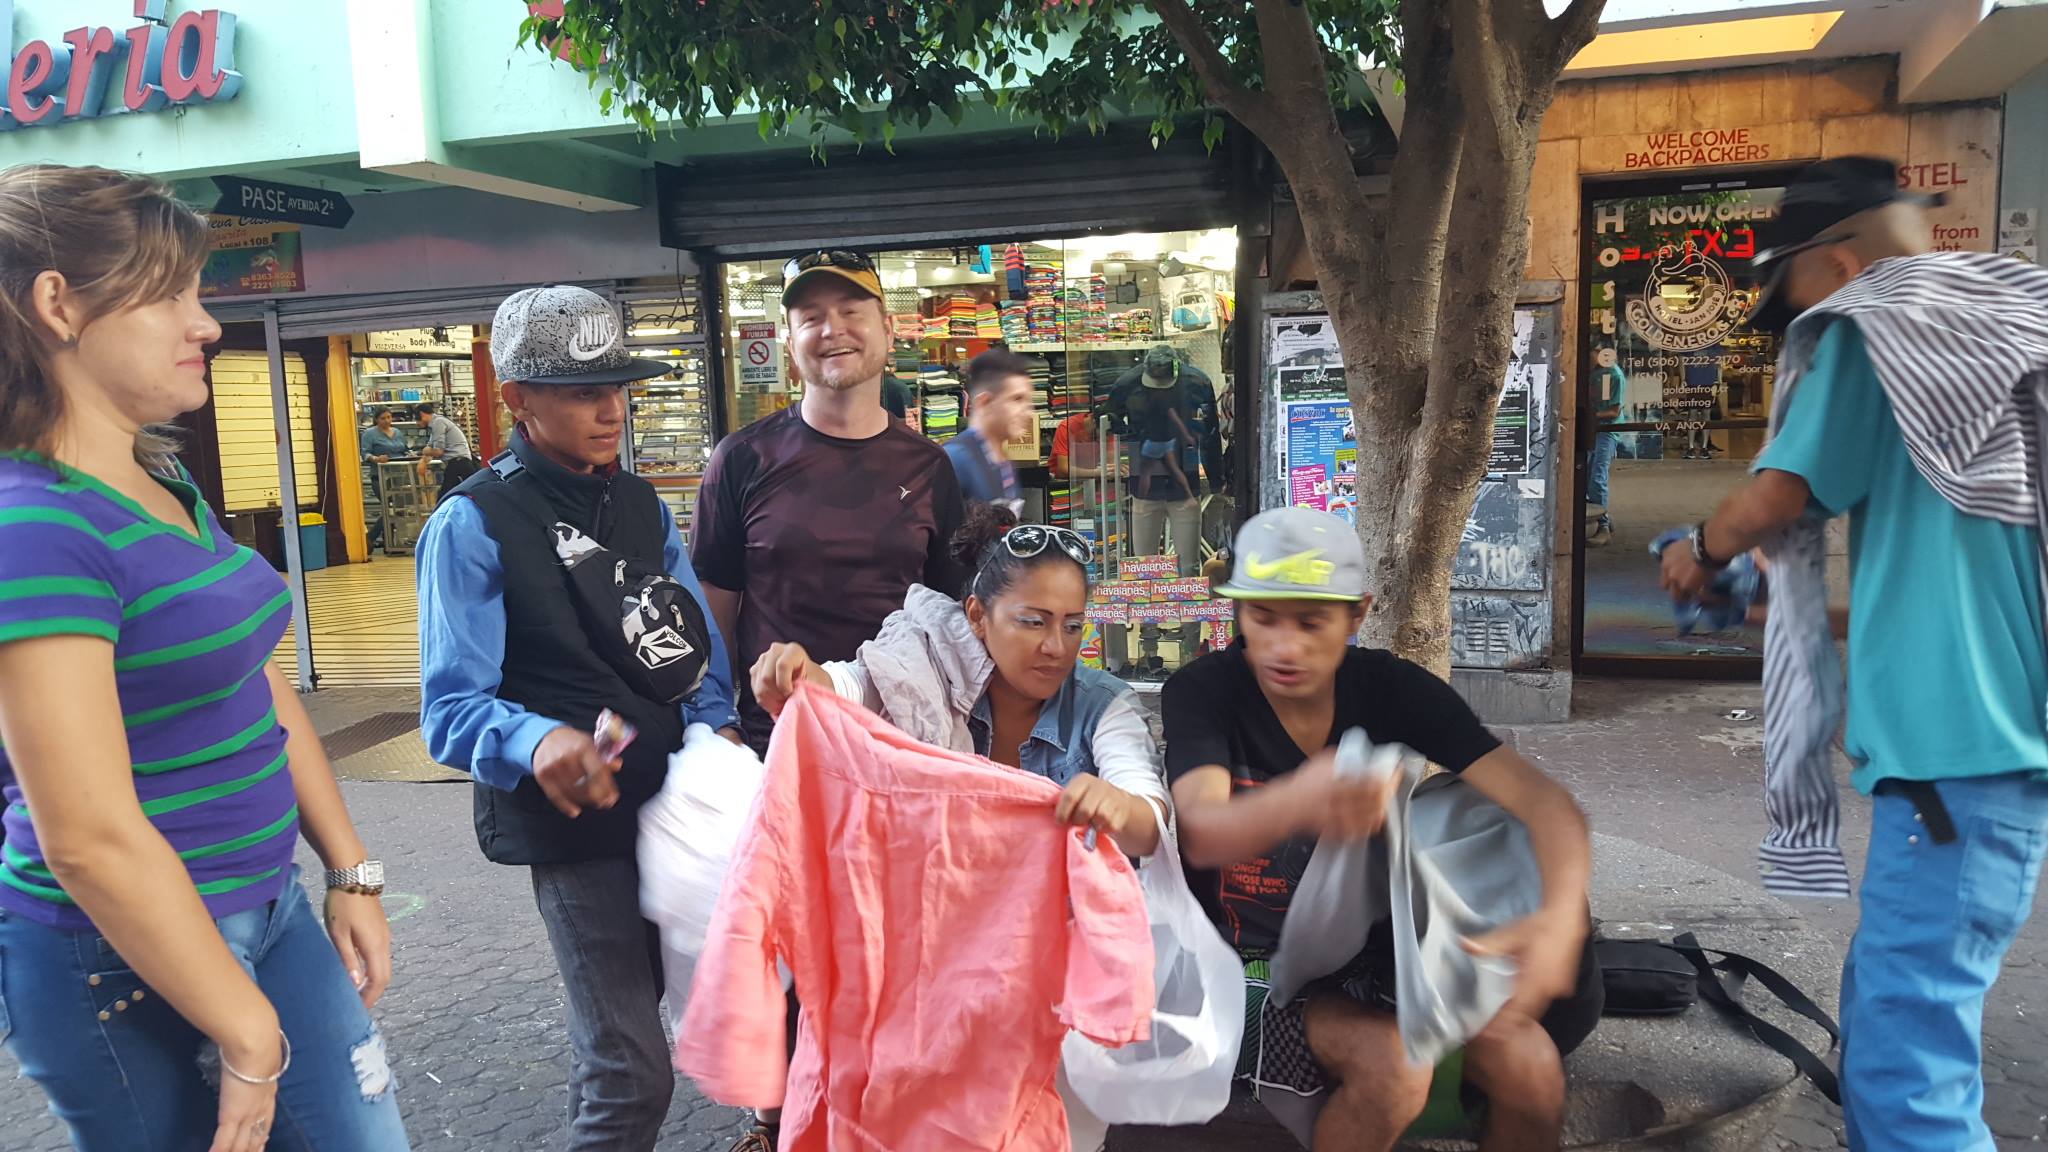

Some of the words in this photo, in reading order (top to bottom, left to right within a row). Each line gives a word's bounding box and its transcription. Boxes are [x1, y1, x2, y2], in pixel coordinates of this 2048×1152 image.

[1647, 128, 1749, 150] WELCOME
[1625, 144, 1770, 168] BACKPACKERS
[241, 184, 287, 213] PASE
[287, 197, 320, 213] AVENIDA
[1650, 205, 1711, 226] NOW
[1932, 224, 1979, 240] from
[579, 313, 613, 347] NIKE
[747, 330, 769, 338] FUMAR
[409, 338, 427, 347] Body
[1647, 355, 1679, 369] (506)
[1123, 561, 1175, 573] havaianas
[1096, 585, 1146, 596] havaianas
[1154, 582, 1206, 594] havaianas
[1131, 607, 1178, 618] havaianas
[1183, 604, 1231, 616] havaianas
[666, 630, 689, 649] VOLCOM
